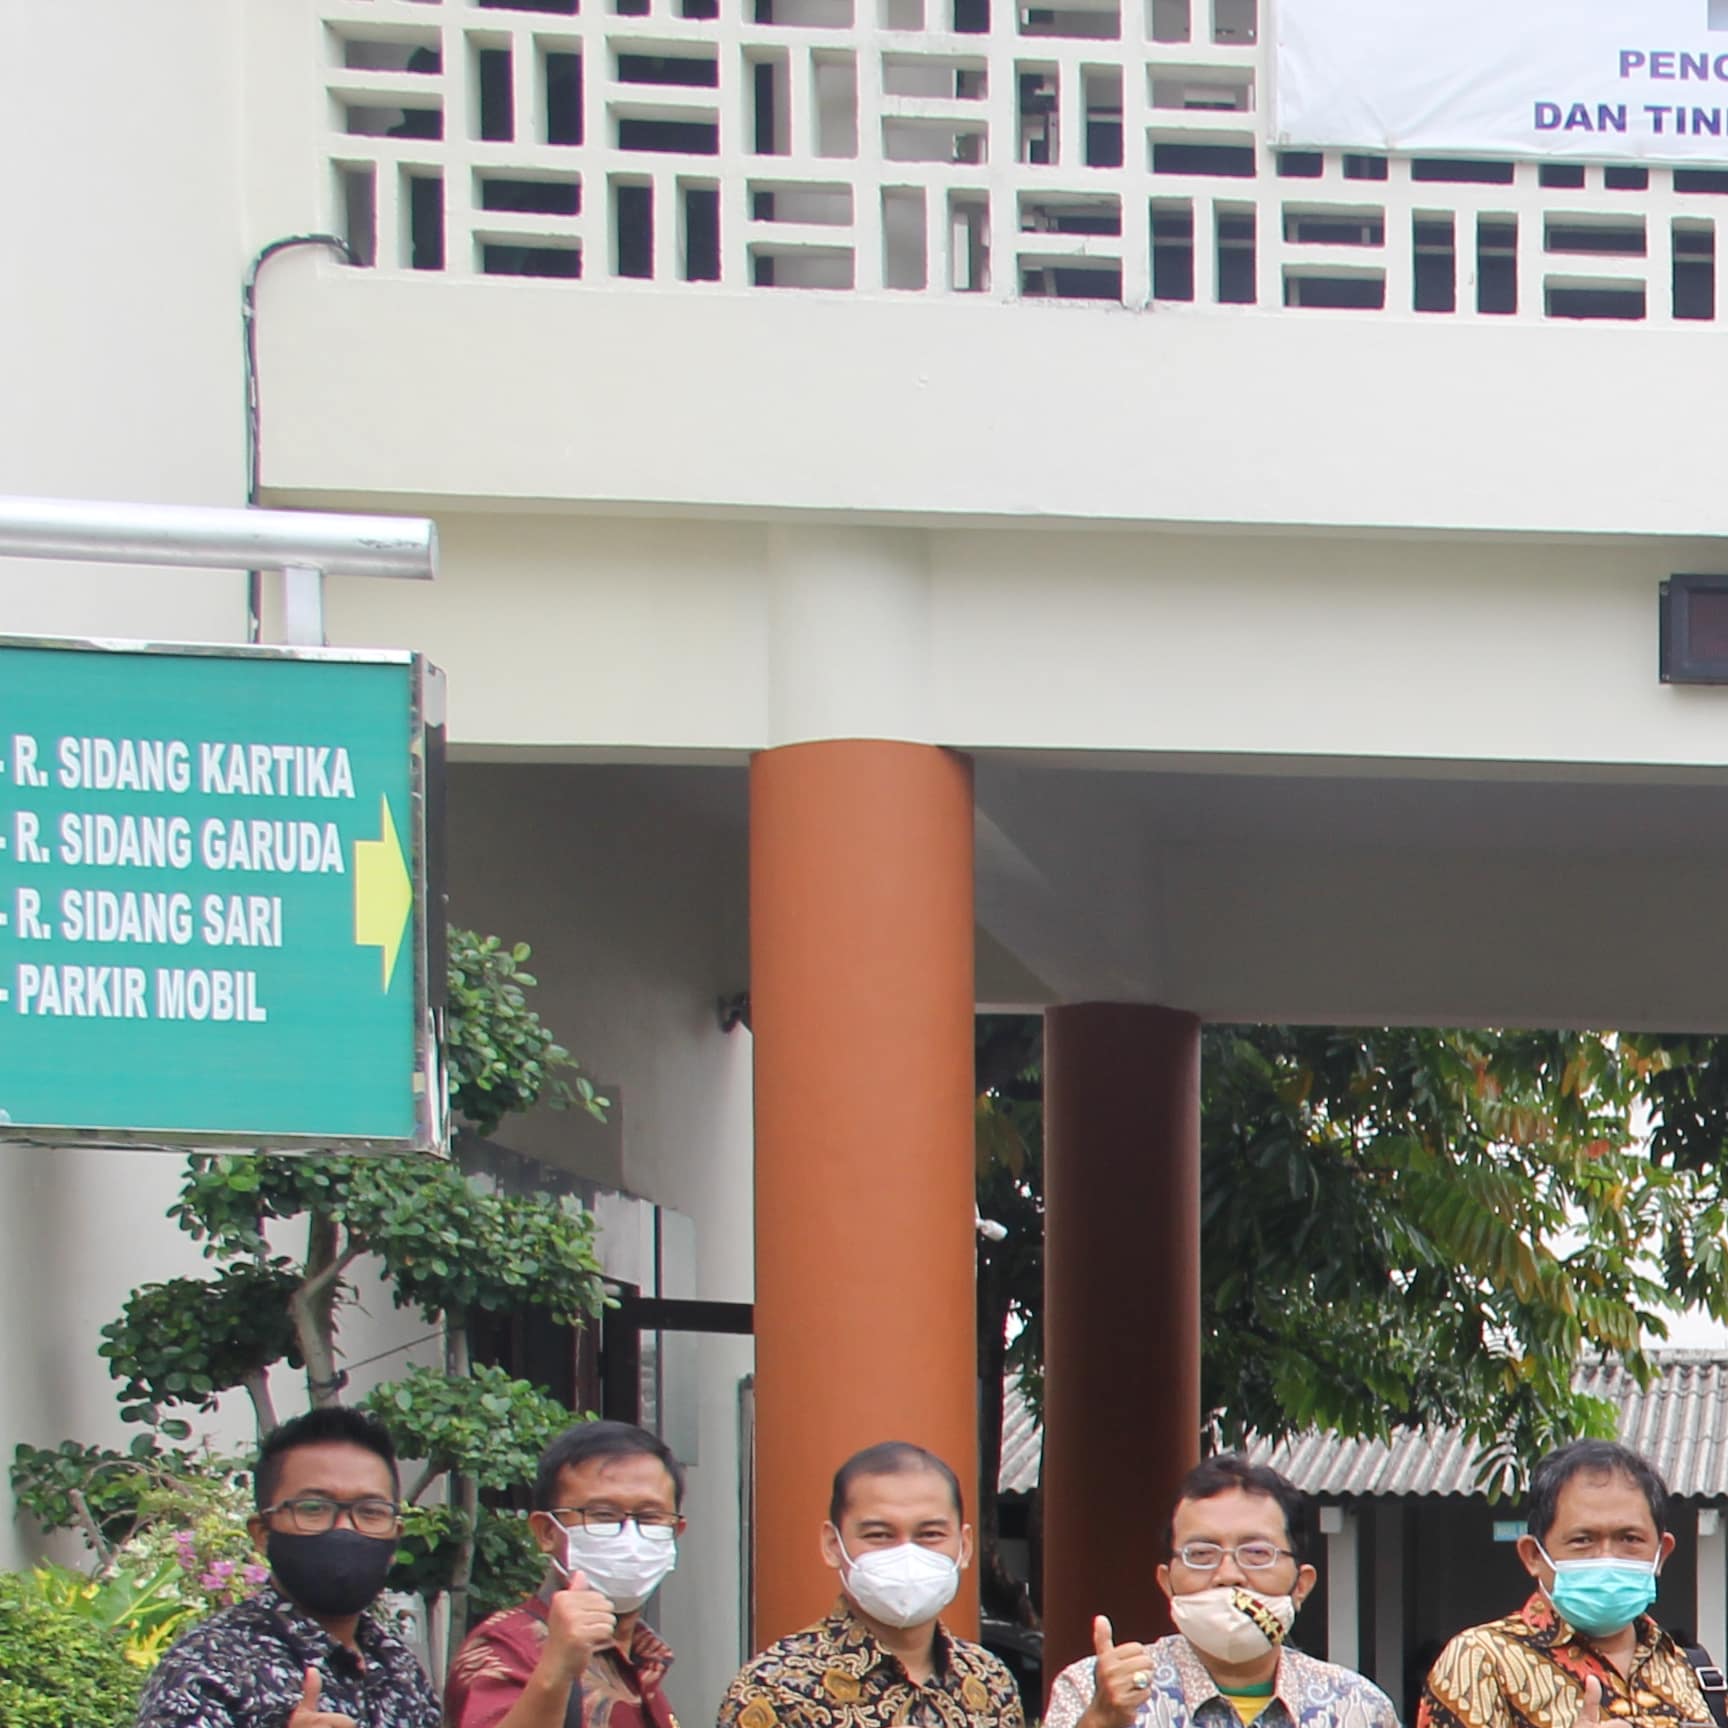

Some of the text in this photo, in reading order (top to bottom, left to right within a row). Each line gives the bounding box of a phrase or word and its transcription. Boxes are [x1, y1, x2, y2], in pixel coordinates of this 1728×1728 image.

[1535, 103, 1627, 133] DAN
[14, 734, 355, 799] R. SIDANG KARTIKA
[15, 810, 345, 874] R. SIDANG GARUDA
[17, 887, 283, 948] R. SIDANG SARI
[17, 963, 267, 1022] PARKIR MOBIL
